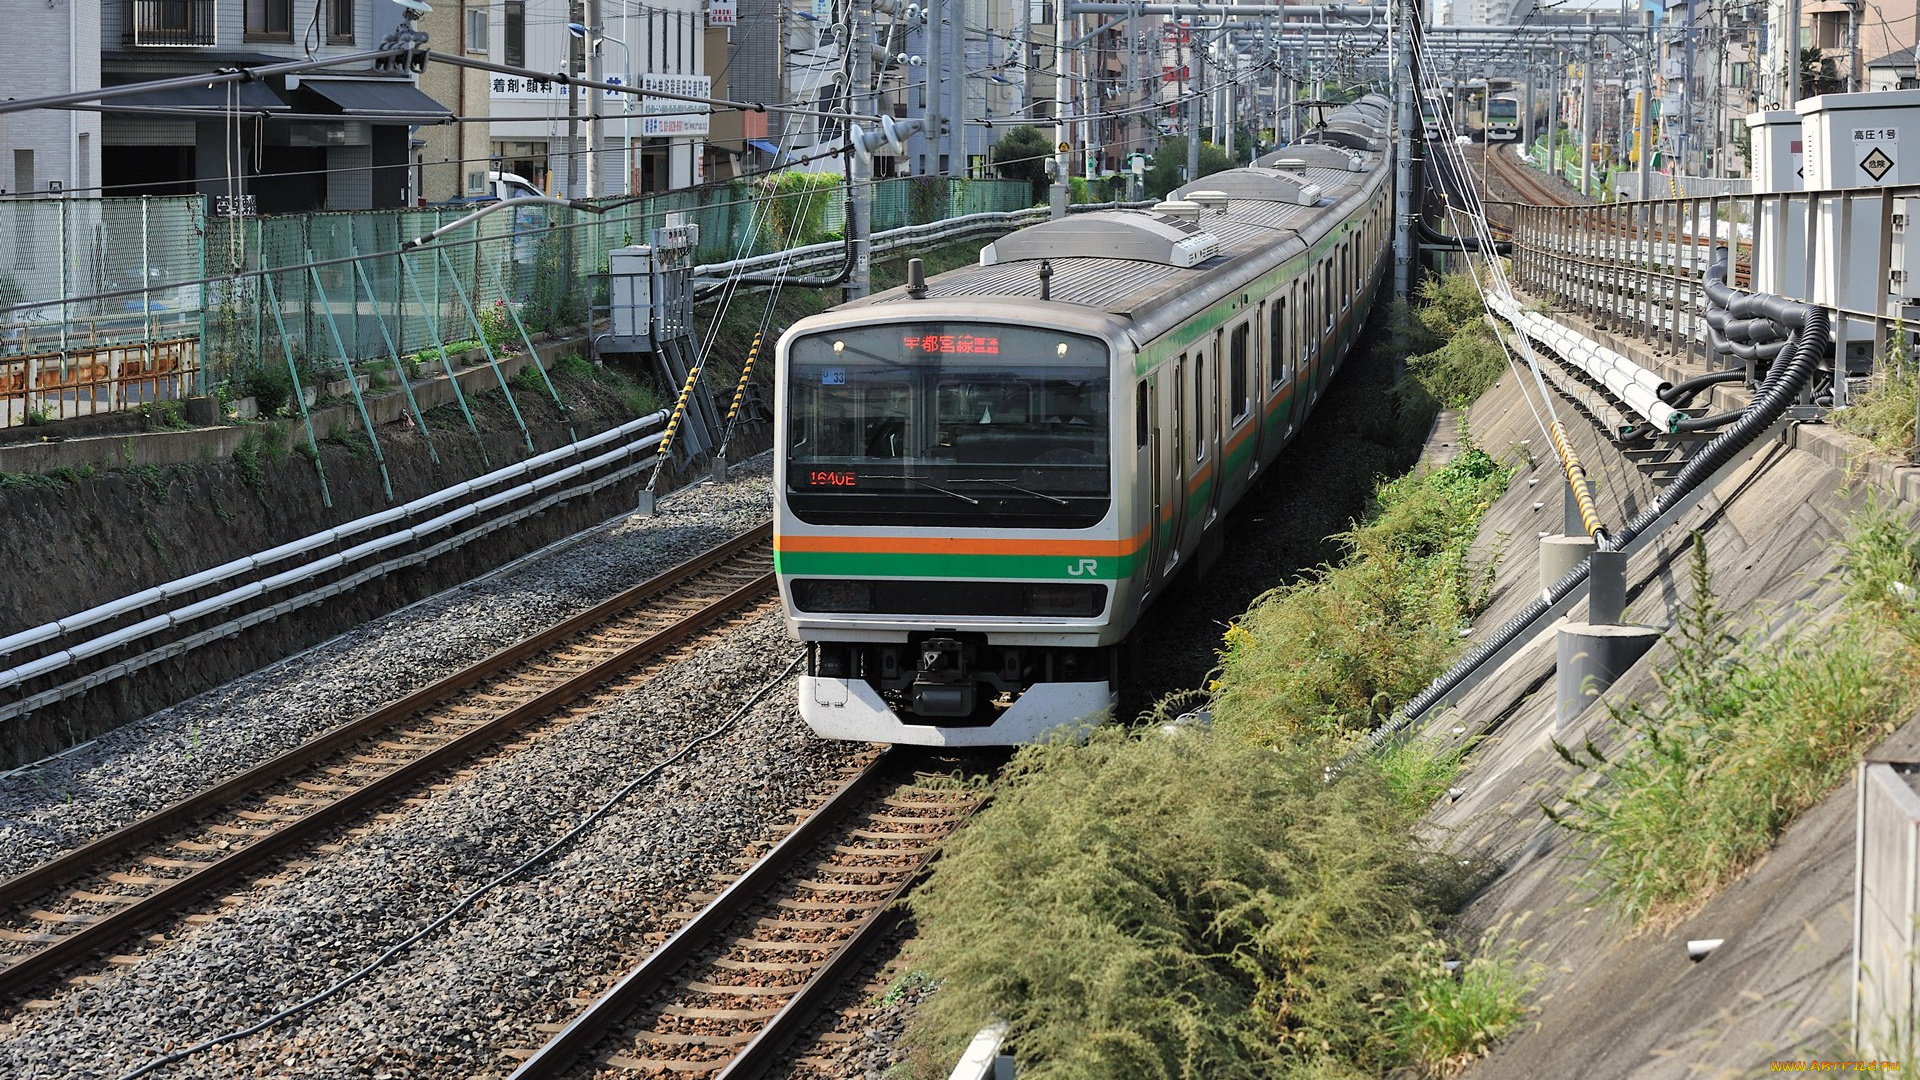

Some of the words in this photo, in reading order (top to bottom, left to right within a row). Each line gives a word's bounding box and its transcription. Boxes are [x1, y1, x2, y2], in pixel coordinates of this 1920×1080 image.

[489, 78, 553, 94] 着剤・顔料
[1854, 129, 1896, 140] 高圧1号
[1868, 160, 1886, 169] 危険
[833, 373, 844, 383] 33
[1068, 559, 1098, 576] JR
